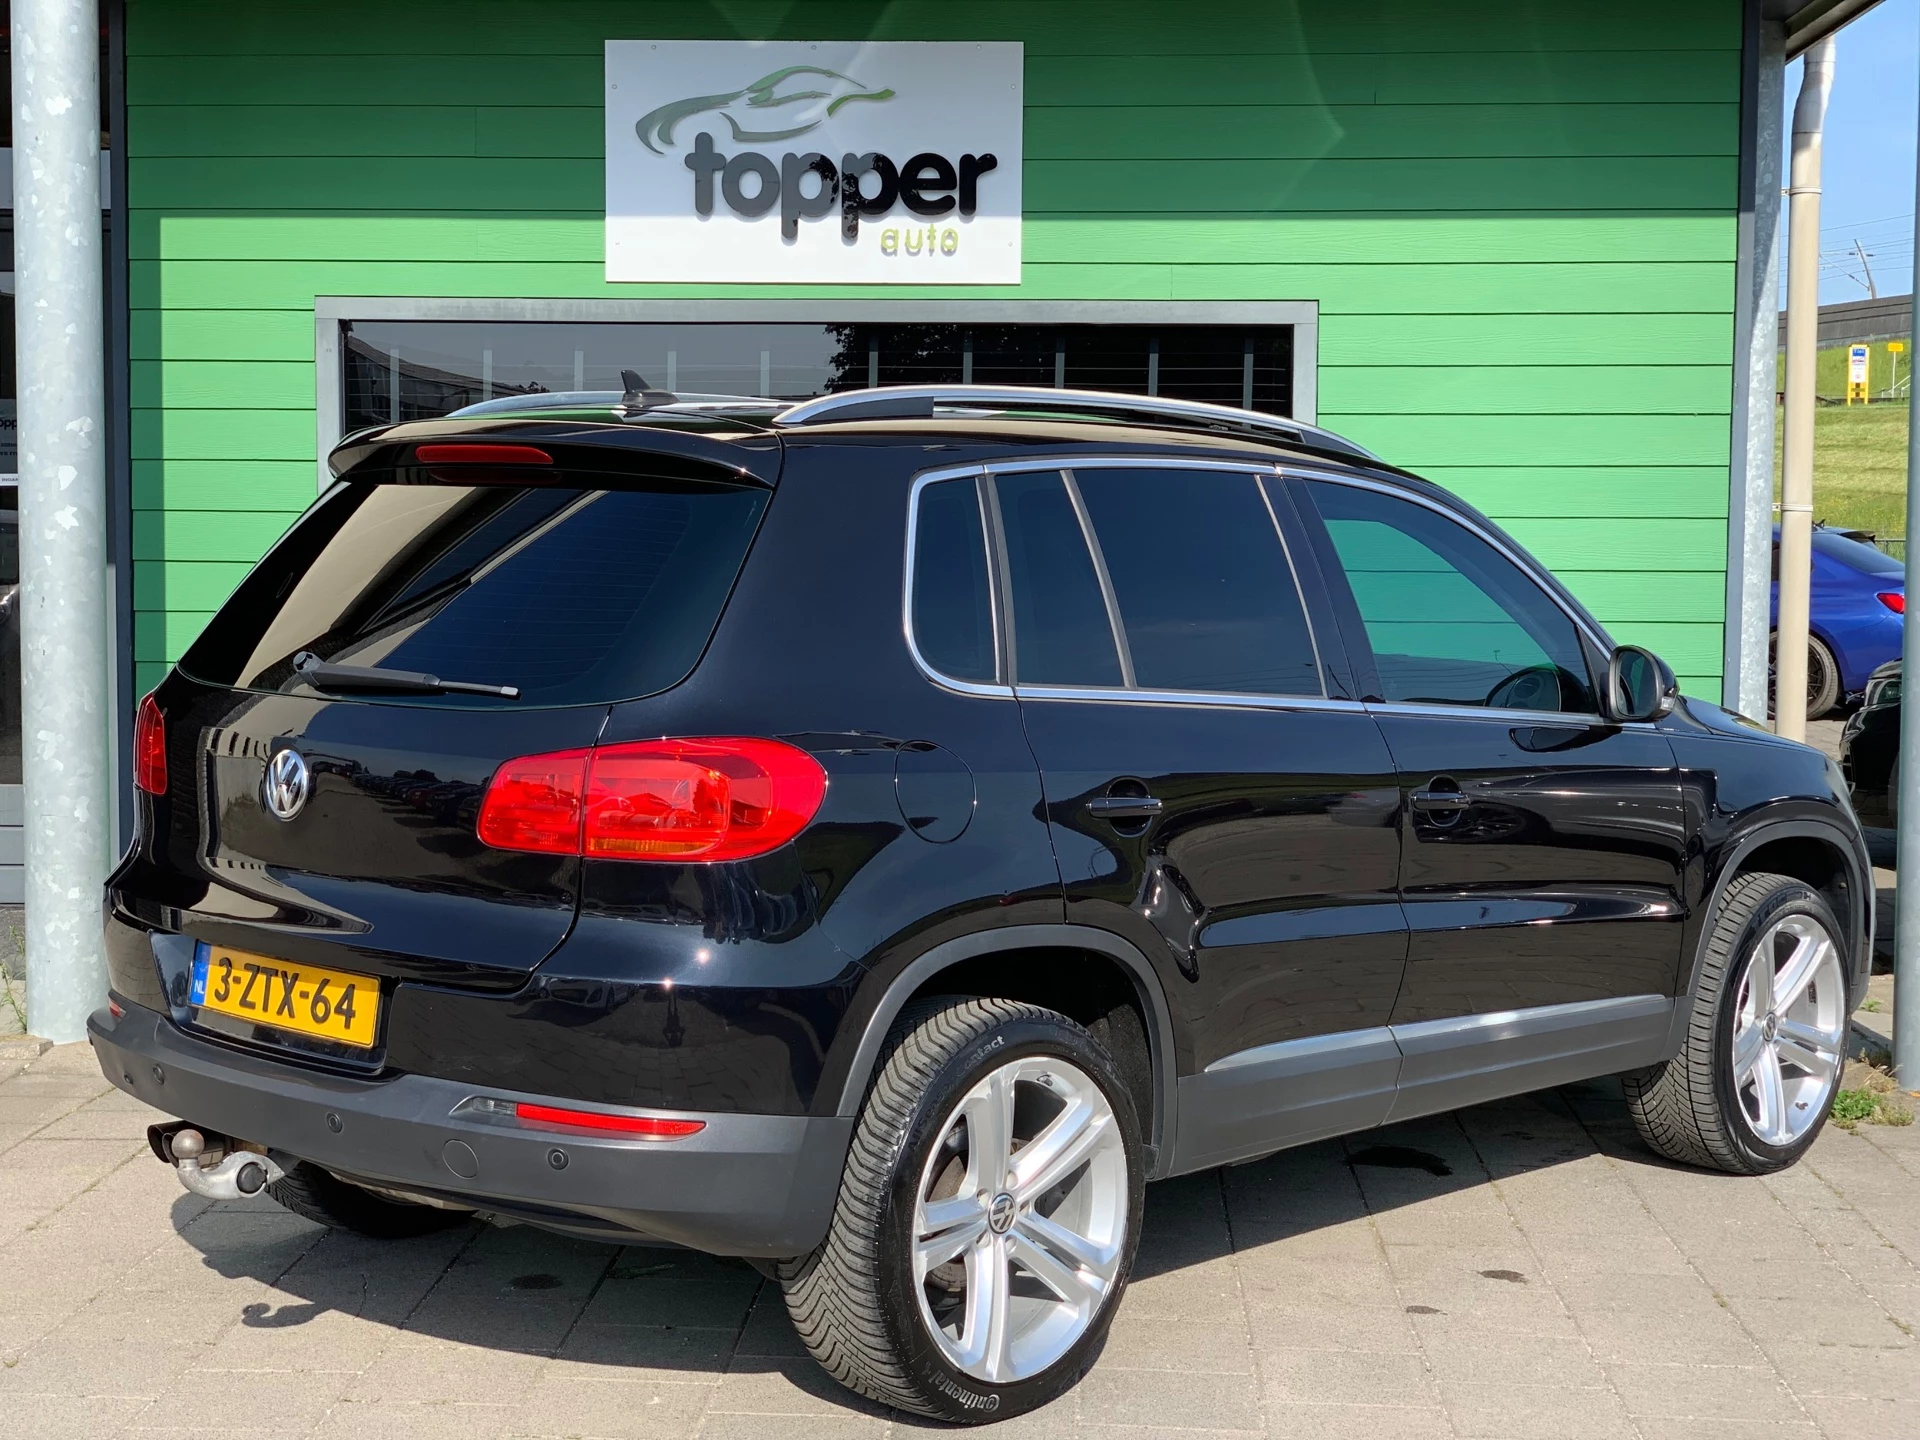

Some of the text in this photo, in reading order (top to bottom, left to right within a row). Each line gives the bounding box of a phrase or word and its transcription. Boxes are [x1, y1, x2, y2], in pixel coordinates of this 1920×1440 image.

[684, 131, 998, 240] topper
[880, 223, 959, 252] auto
[194, 979, 205, 995] NL
[214, 956, 356, 1030] 3-ZTX-64
[928, 1369, 1001, 1413] Continental
